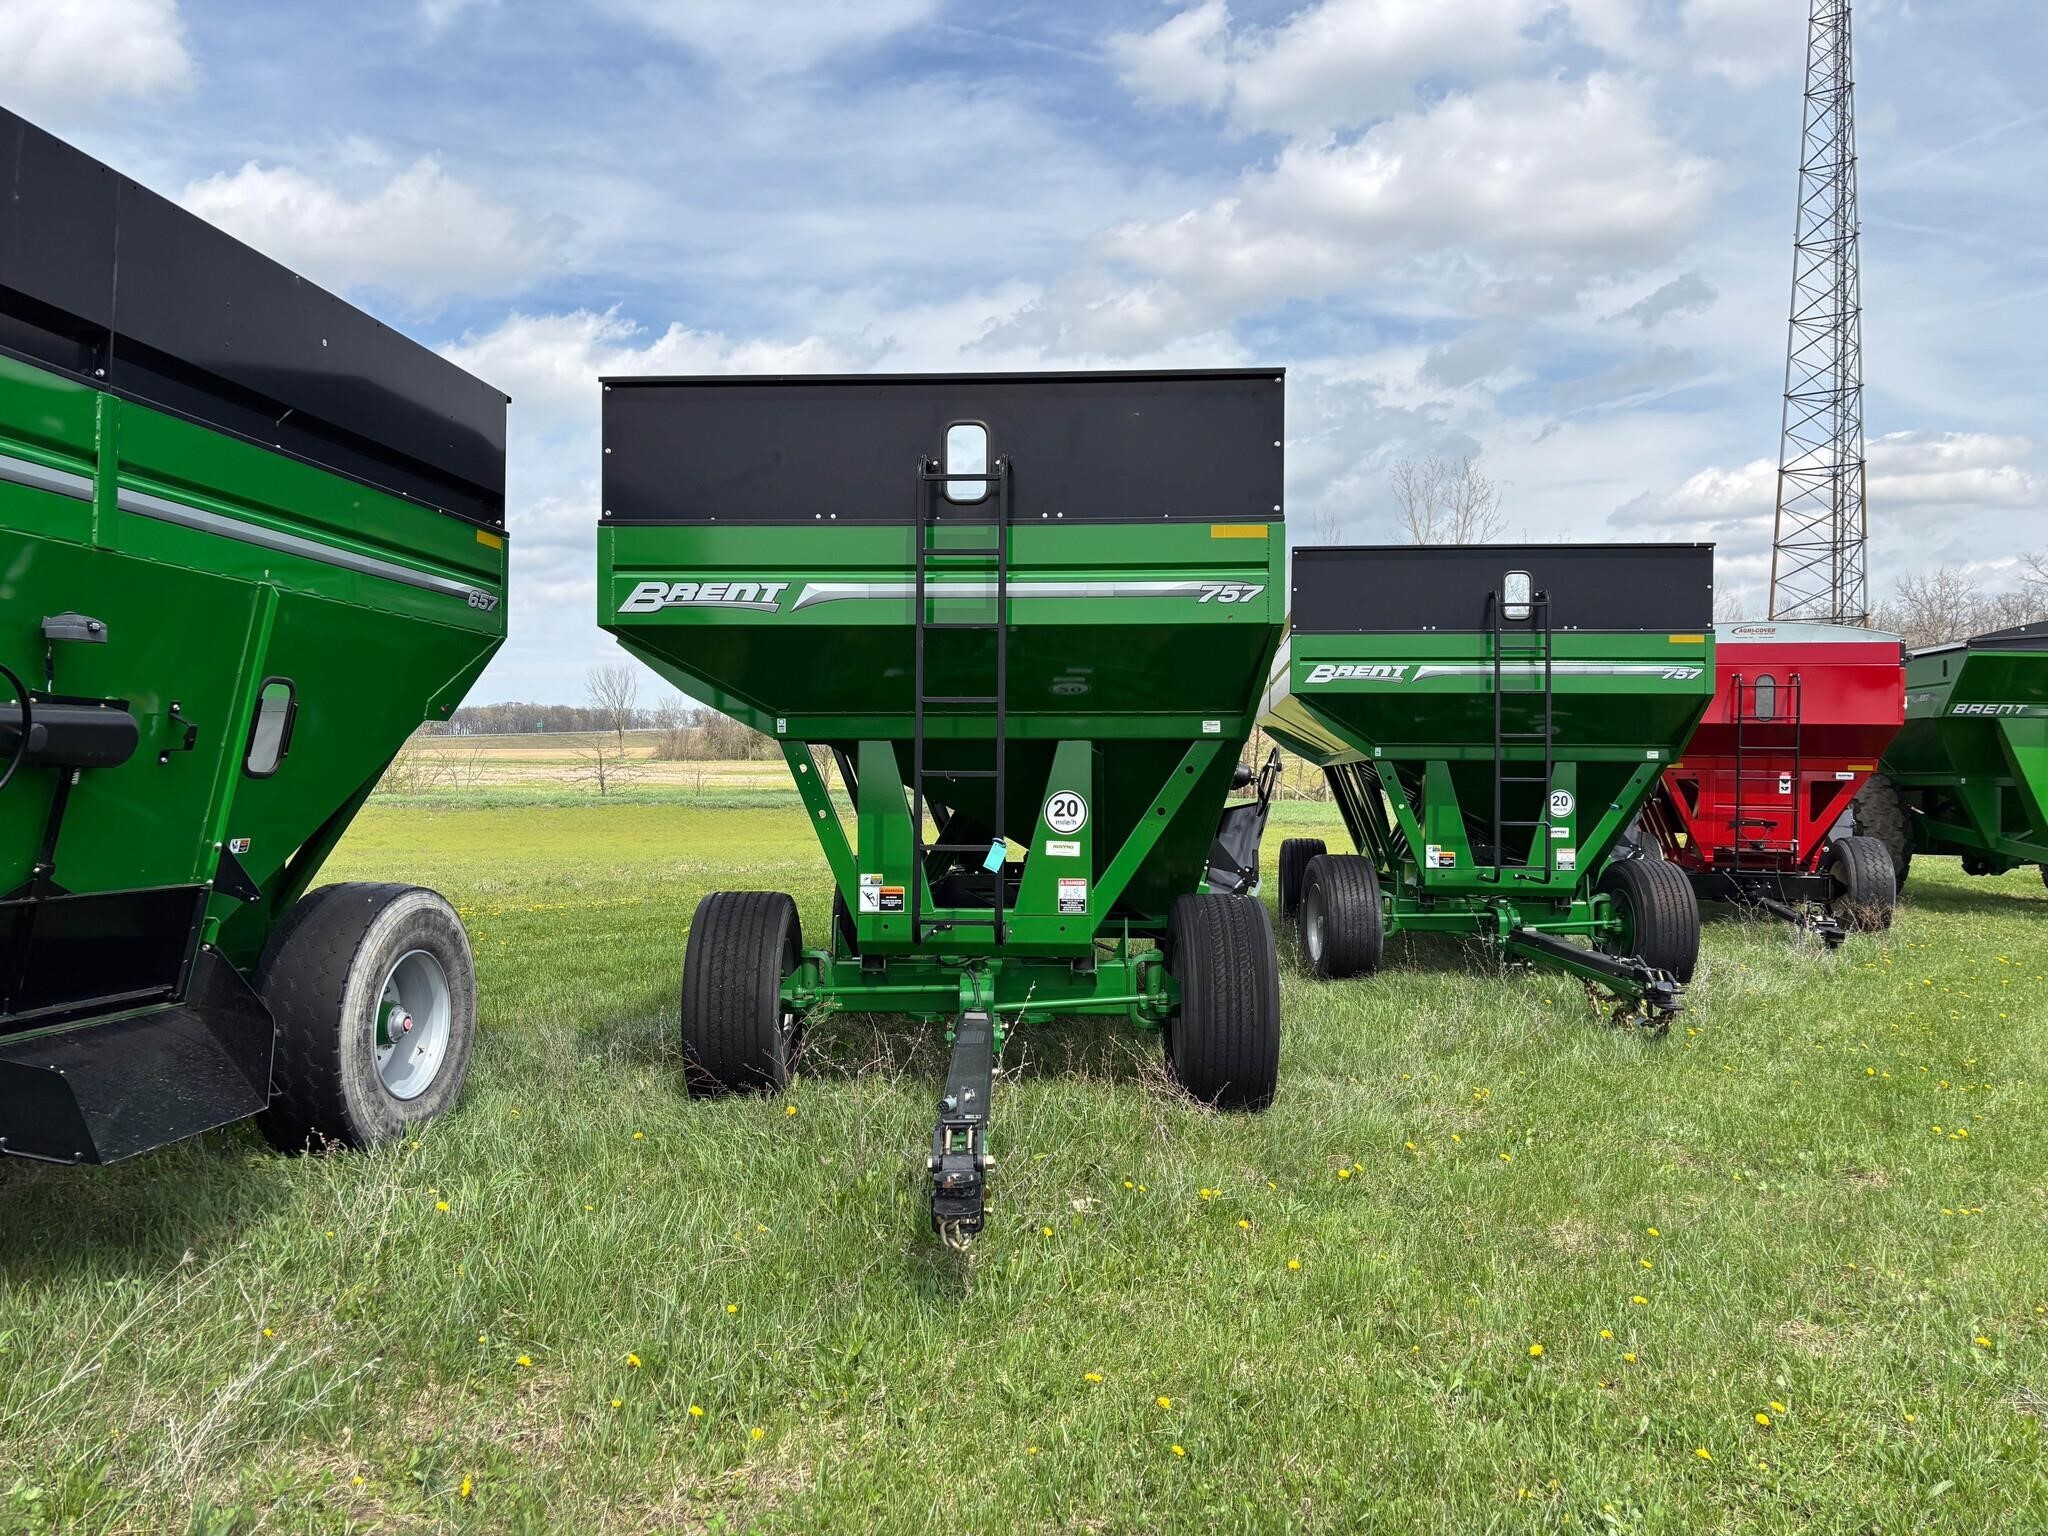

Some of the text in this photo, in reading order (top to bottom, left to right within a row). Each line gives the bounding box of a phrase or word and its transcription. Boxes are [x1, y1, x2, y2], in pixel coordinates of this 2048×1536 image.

[468, 590, 499, 611] 657
[617, 581, 790, 613] BRENT
[1198, 584, 1266, 603] 757
[1304, 664, 1410, 684] BRENT
[1662, 667, 1704, 680] 757
[1952, 703, 2029, 715] BRENT
[1053, 799, 1079, 817] 20
[1552, 795, 1568, 807] 20
